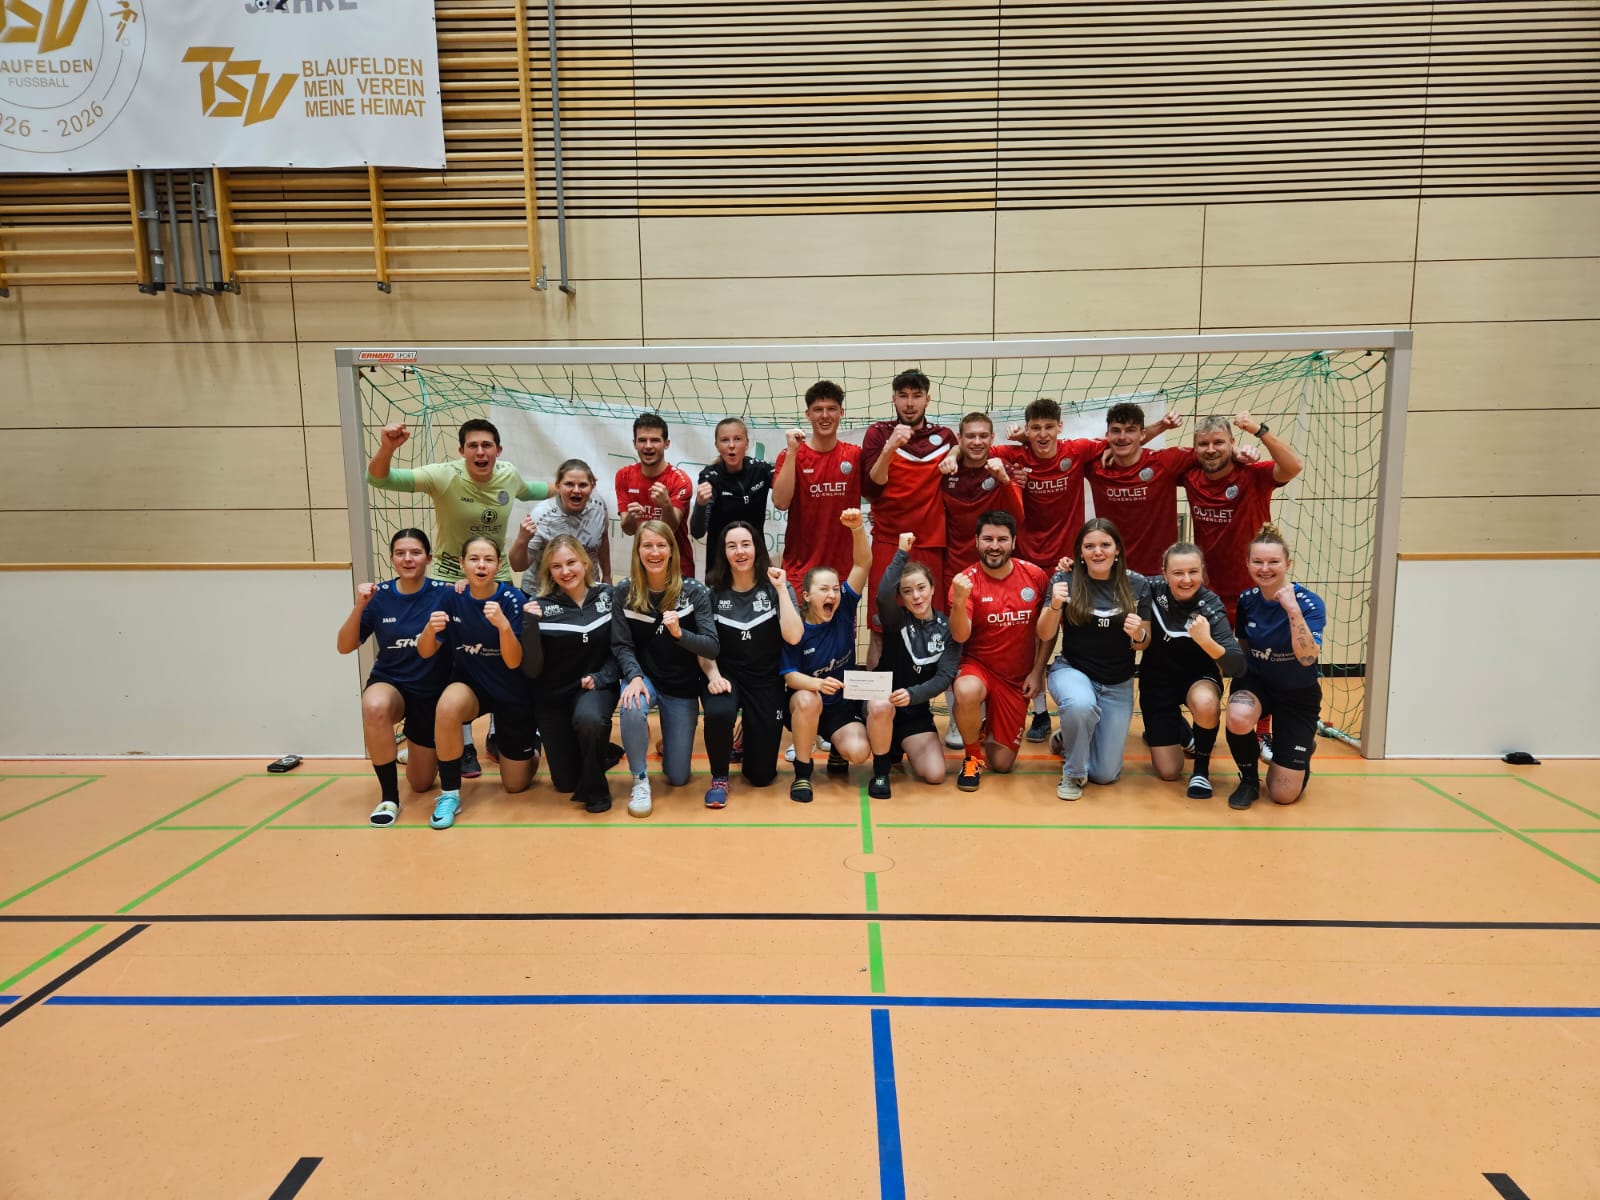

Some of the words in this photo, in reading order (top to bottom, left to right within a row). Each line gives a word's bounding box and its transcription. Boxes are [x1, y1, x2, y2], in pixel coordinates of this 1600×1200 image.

[0, 0, 89, 54] SV
[302, 57, 423, 77] BLAUFELDEN
[8, 77, 70, 88] FUSSBALL
[181, 46, 300, 127] TSV
[304, 79, 345, 97] MEIN
[357, 78, 424, 97] VEREIN
[305, 99, 355, 117] MEINE
[361, 99, 426, 117] HEIMAT
[57, 100, 104, 137] 2026
[810, 482, 847, 494] OUTLET
[1028, 476, 1069, 490] OUTLET
[1106, 486, 1148, 498] OUTLET
[1193, 505, 1234, 518] OUTLET
[987, 609, 1032, 623] OUTLET
[1097, 618, 1109, 627] 30
[582, 633, 589, 643] 5
[740, 630, 752, 641] 24
